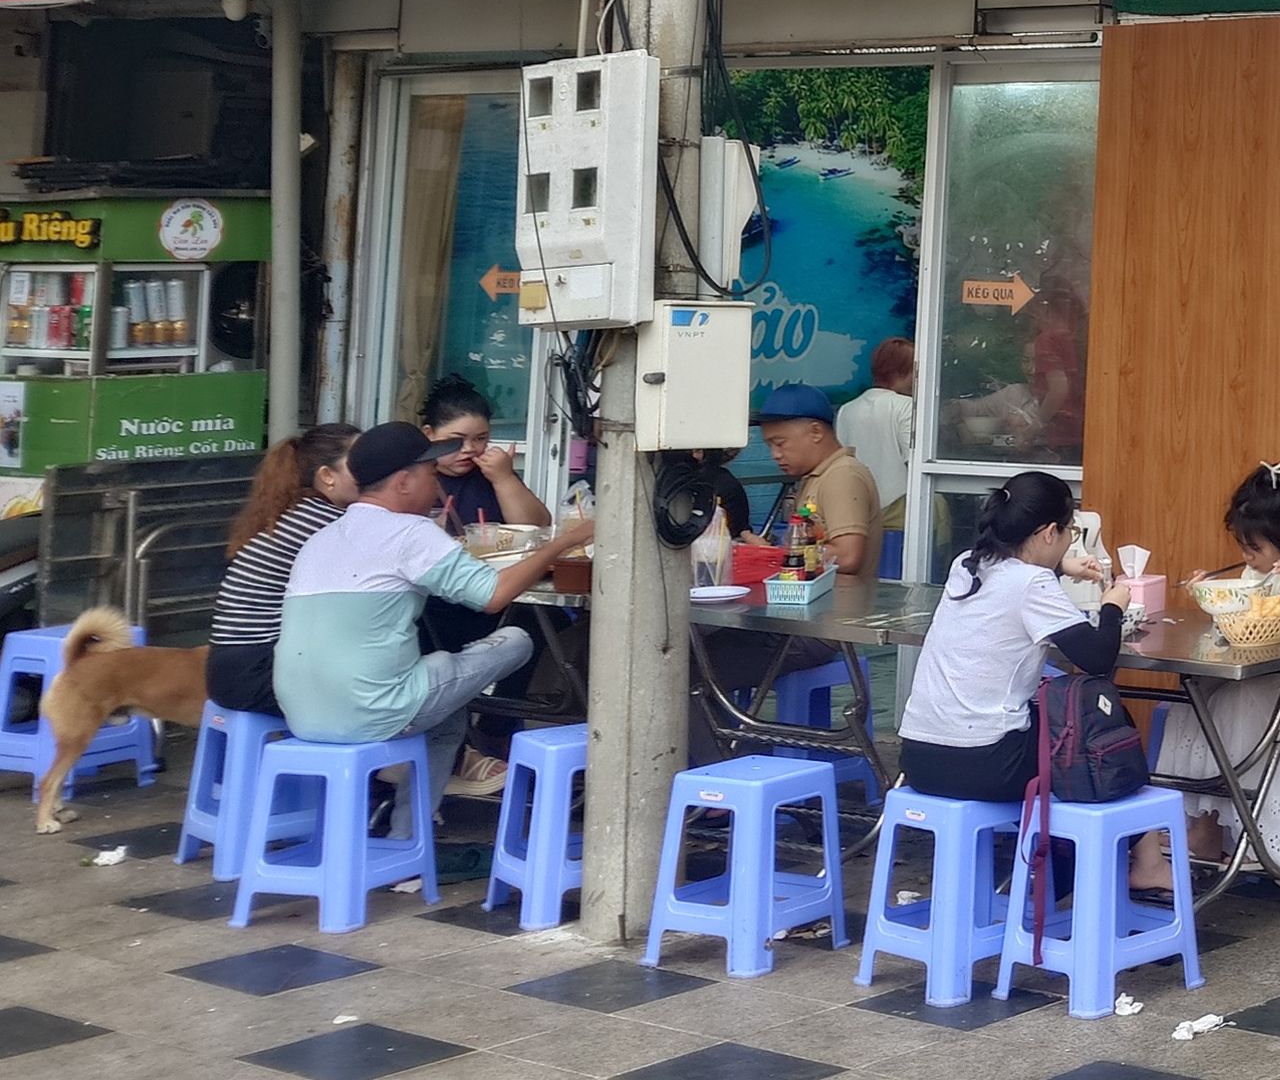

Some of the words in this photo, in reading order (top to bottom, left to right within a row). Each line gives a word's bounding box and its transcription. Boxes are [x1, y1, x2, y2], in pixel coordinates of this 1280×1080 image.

[22, 210, 94, 248] Riêng
[992, 287, 1014, 301] QUA
[119, 417, 184, 436] Nước
[190, 414, 235, 432] mía
[95, 444, 129, 461] Sầu
[135, 444, 184, 459] Riêng
[189, 439, 219, 454] Cốt
[224, 438, 255, 452] Dừa
